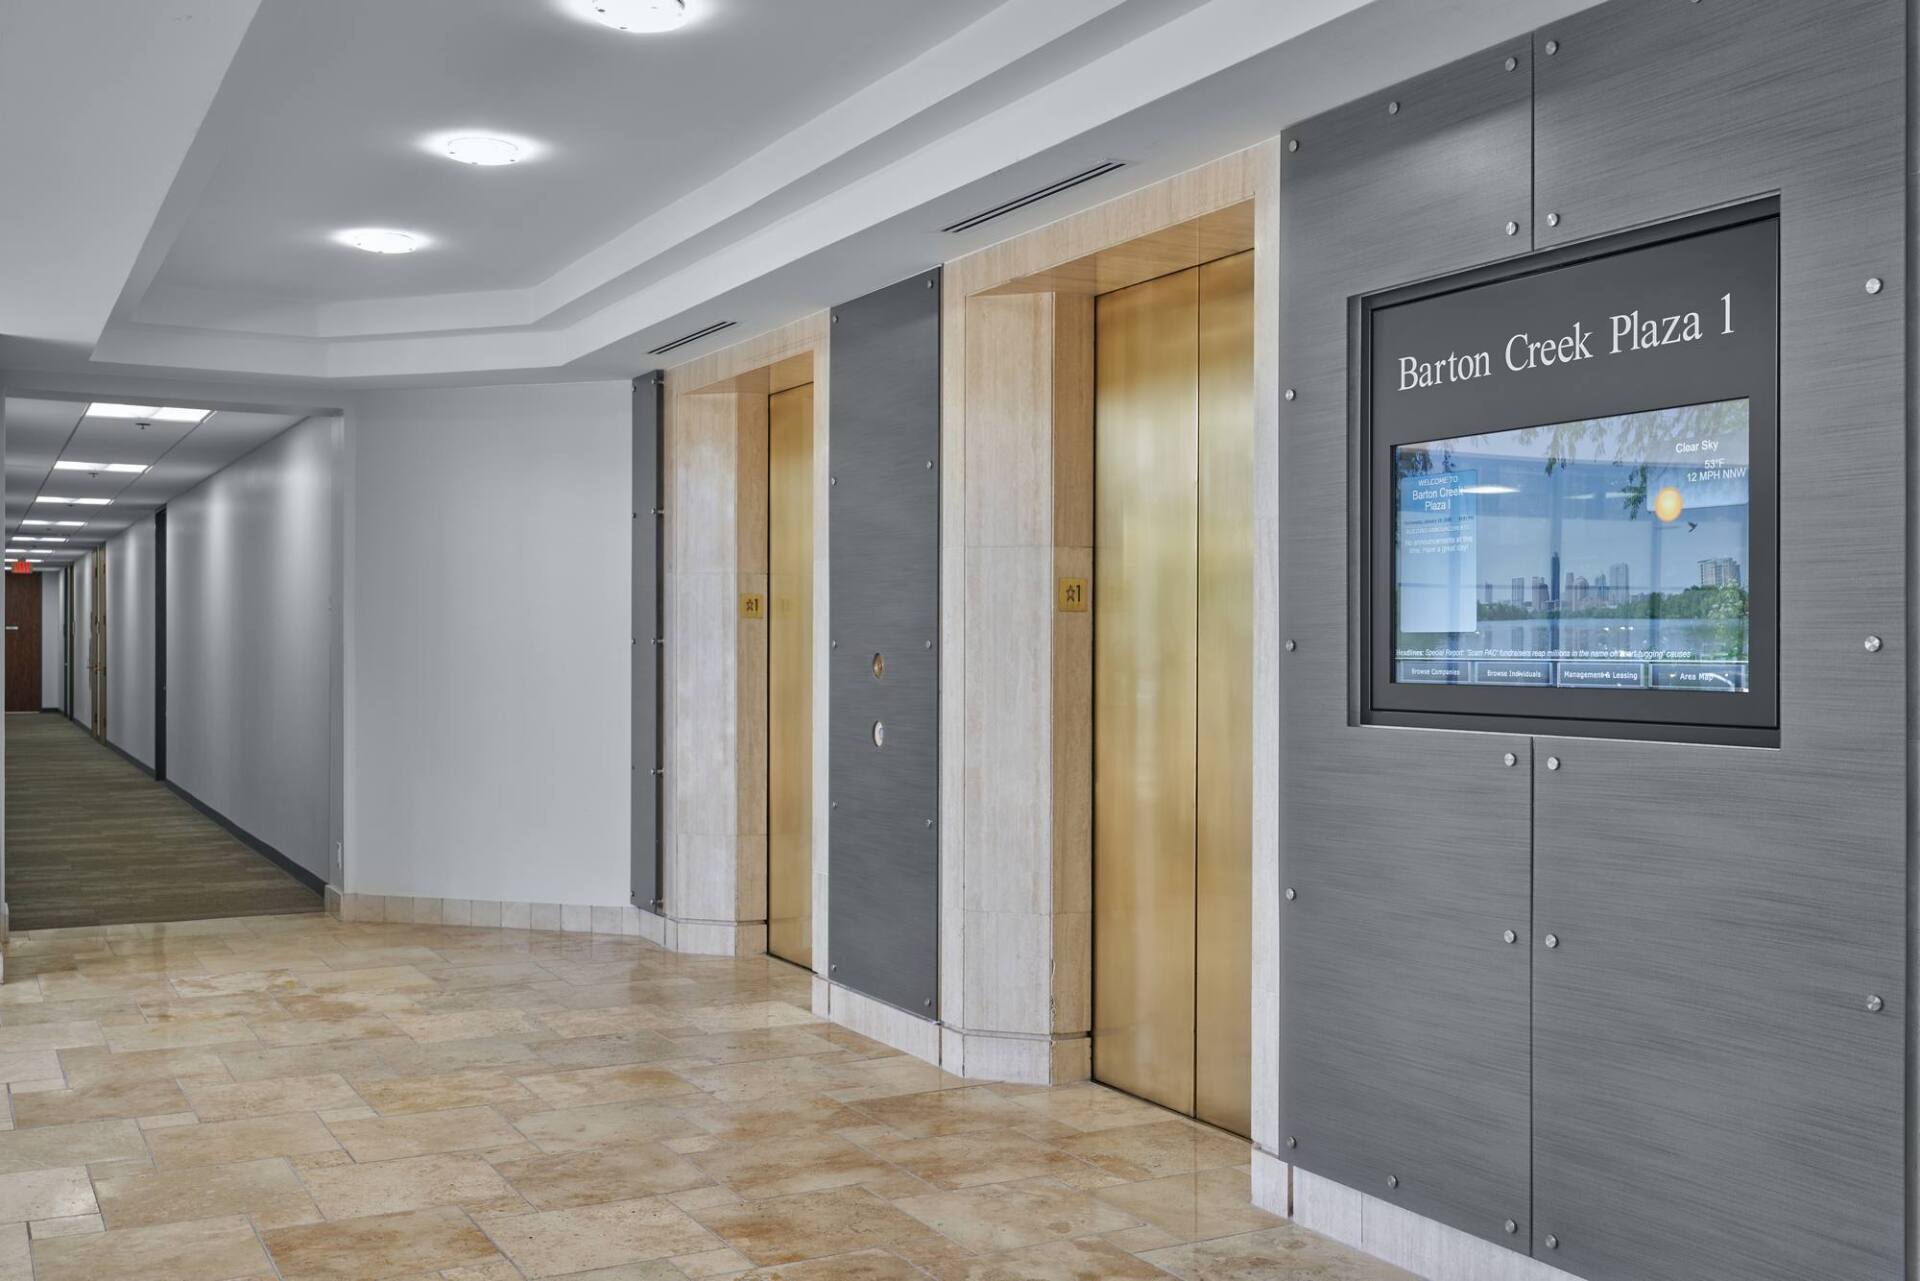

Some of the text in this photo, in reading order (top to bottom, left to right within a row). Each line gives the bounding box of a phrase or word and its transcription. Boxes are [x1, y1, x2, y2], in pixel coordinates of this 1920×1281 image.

[1397, 292, 1735, 391] Barton Creek Plaza 1
[1675, 440, 1719, 453] Clear Sky
[1687, 467, 1746, 482] 12 MPH NNW
[1412, 486, 1465, 501] Barton Creek
[1424, 500, 1446, 511] Plaza
[1076, 584, 1081, 602] 1
[754, 598, 759, 611] 1
[1532, 650, 1546, 658] reap
[1666, 650, 1691, 658] causes
[1431, 668, 1460, 676] Companies
[1487, 669, 1541, 678] Browse Individuals
[1564, 671, 1604, 679] Management
[1612, 672, 1638, 680] Leasing
[1679, 672, 1714, 682] Area Map
